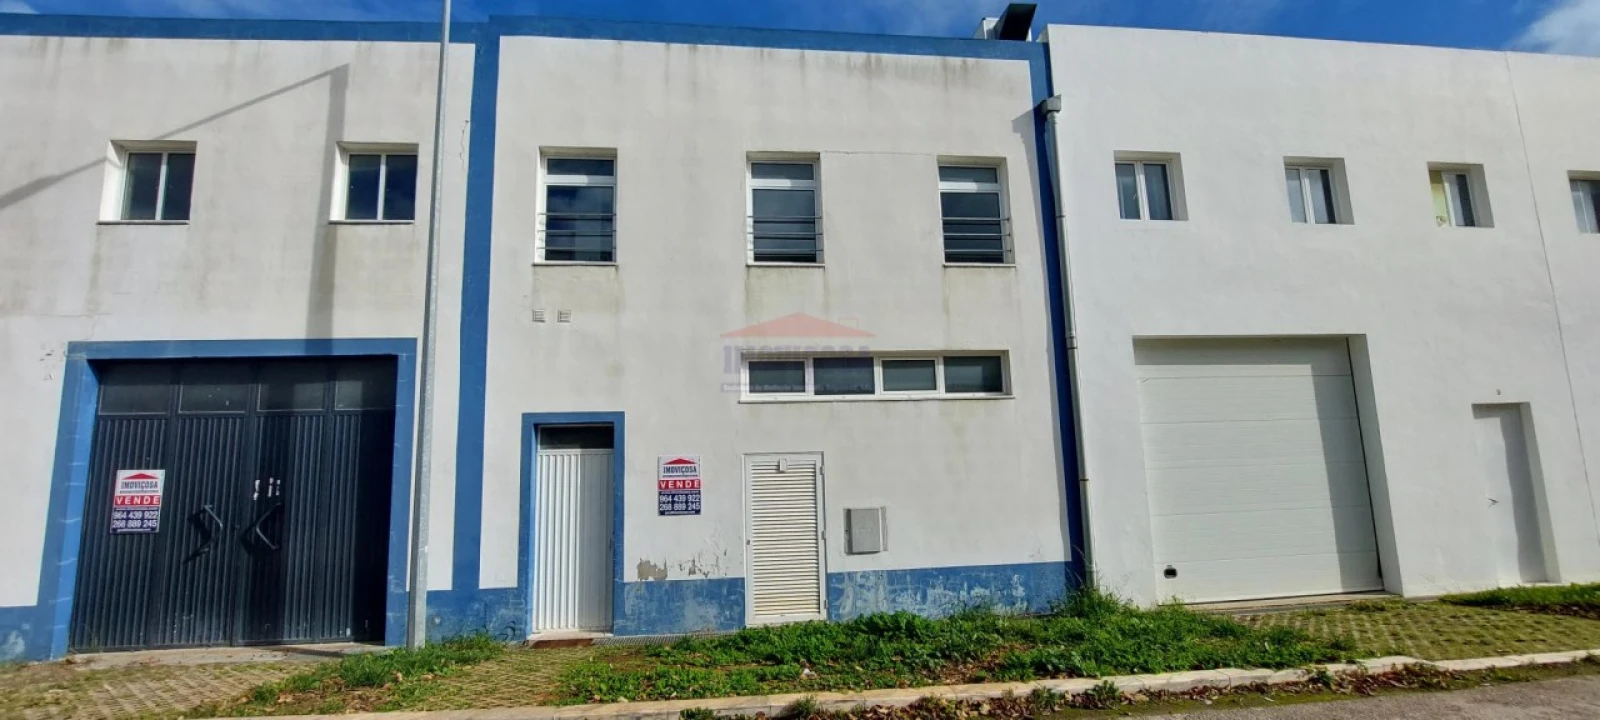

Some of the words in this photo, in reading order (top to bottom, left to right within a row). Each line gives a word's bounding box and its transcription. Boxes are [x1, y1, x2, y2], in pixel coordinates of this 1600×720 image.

[660, 480, 700, 489] VENDE
[117, 495, 160, 505] VENDE
[142, 519, 157, 528] 245
